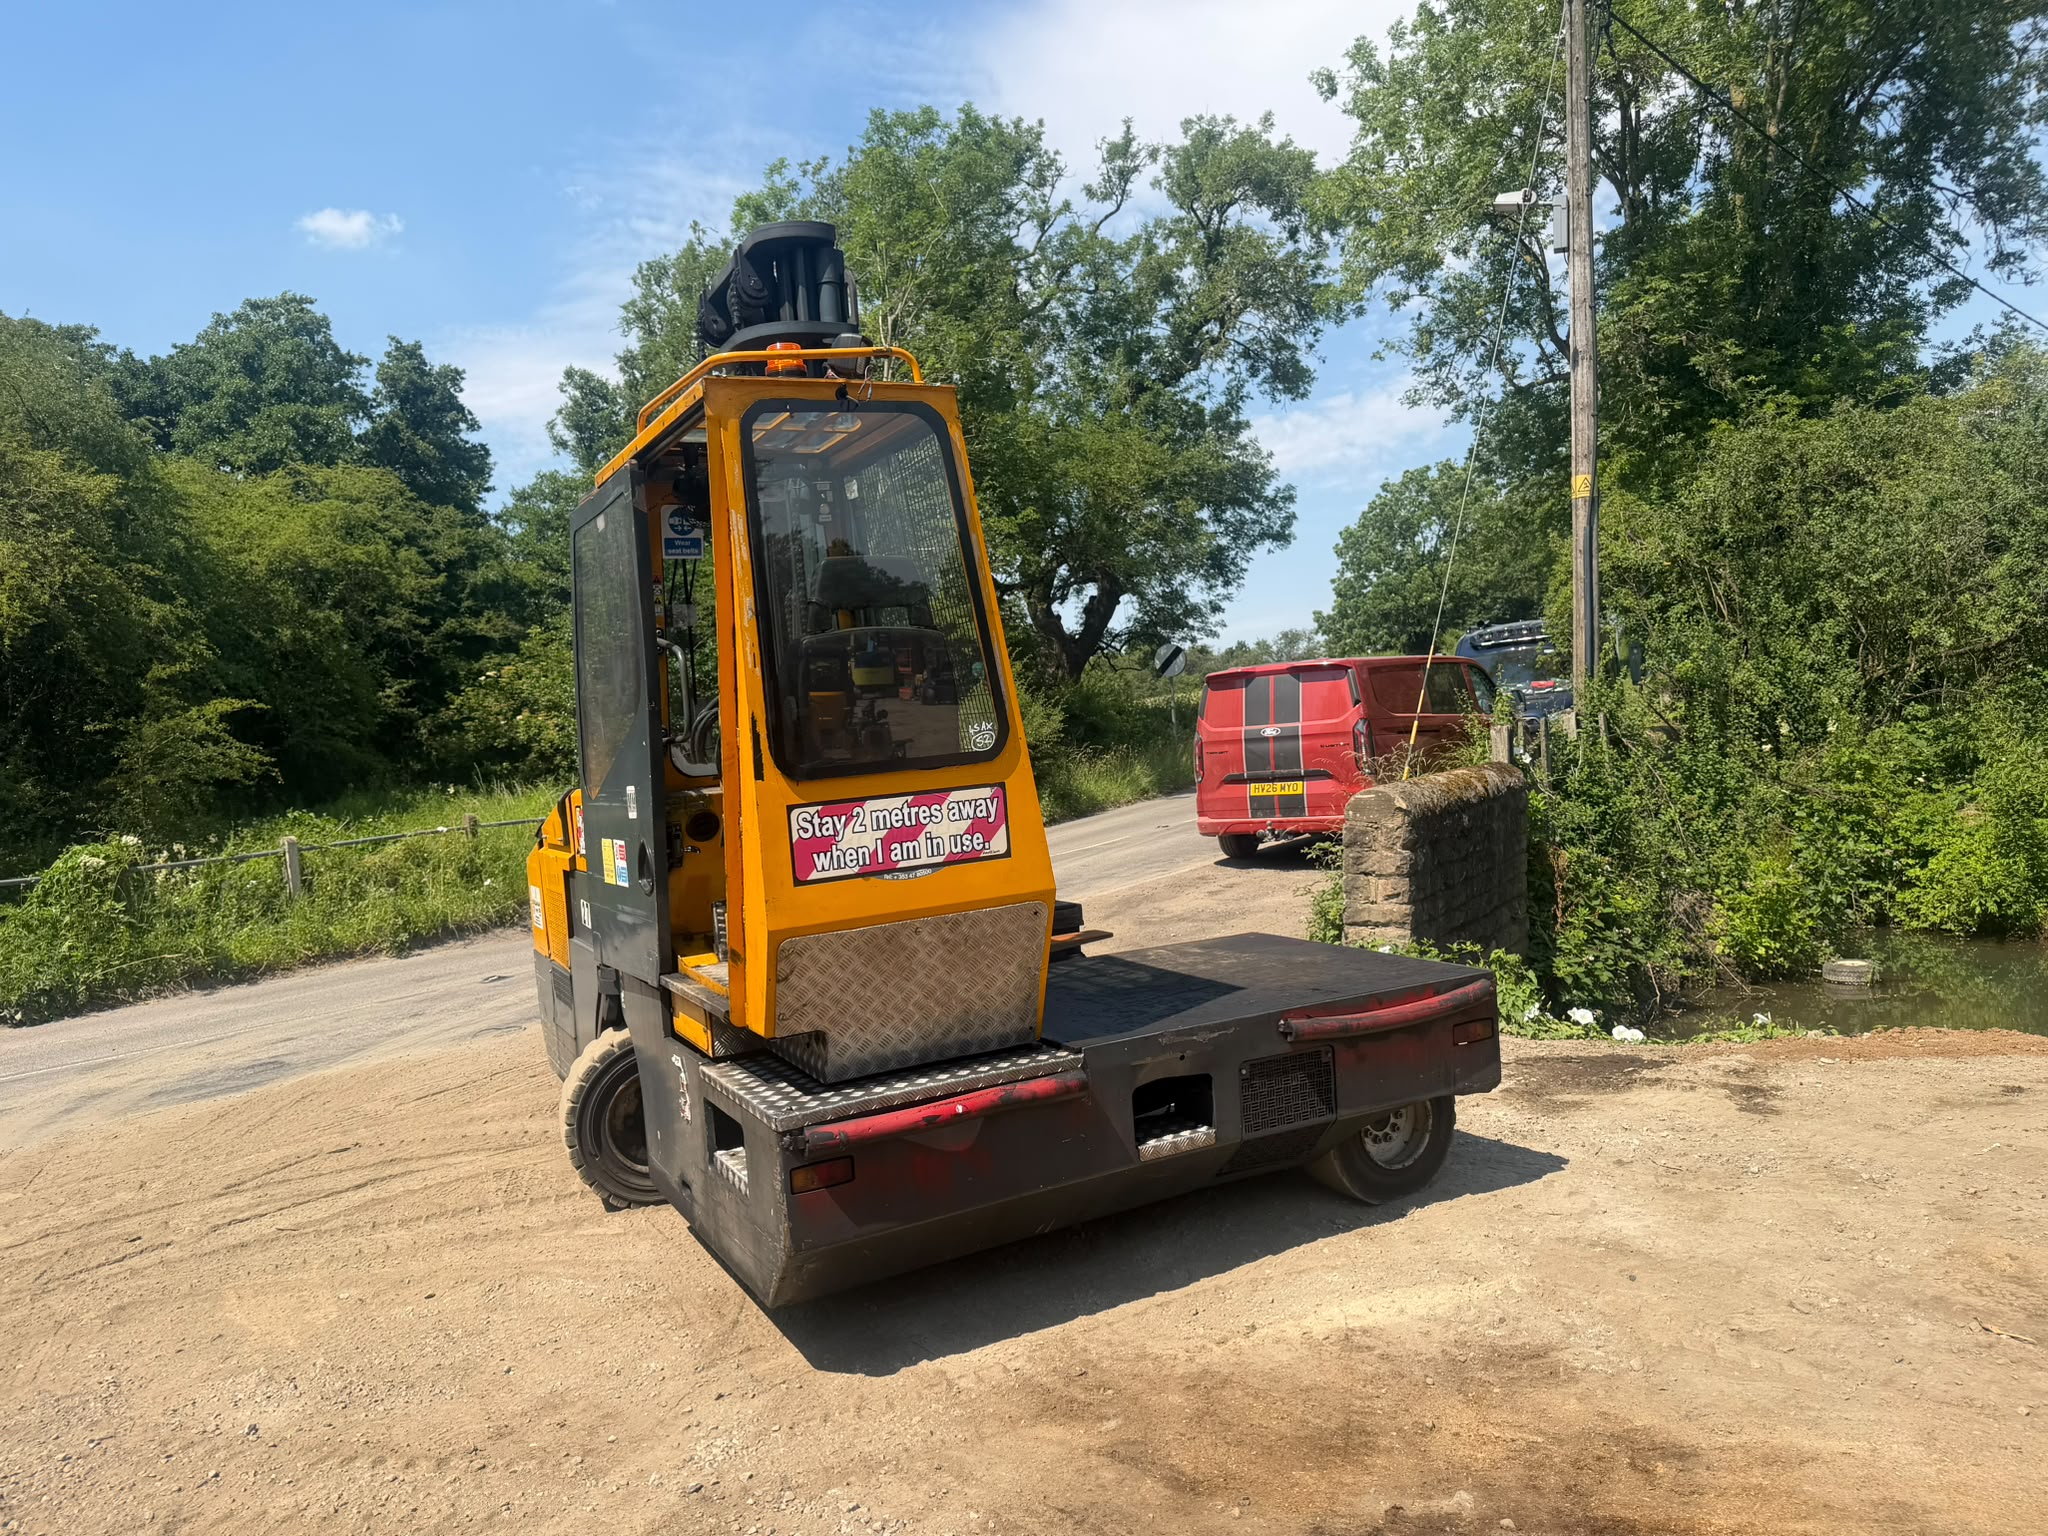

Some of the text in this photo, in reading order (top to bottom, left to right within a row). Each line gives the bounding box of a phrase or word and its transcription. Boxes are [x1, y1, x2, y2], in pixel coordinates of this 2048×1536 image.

[797, 796, 998, 842] Stay 2 metres away
[811, 831, 991, 872] when I am in use.
